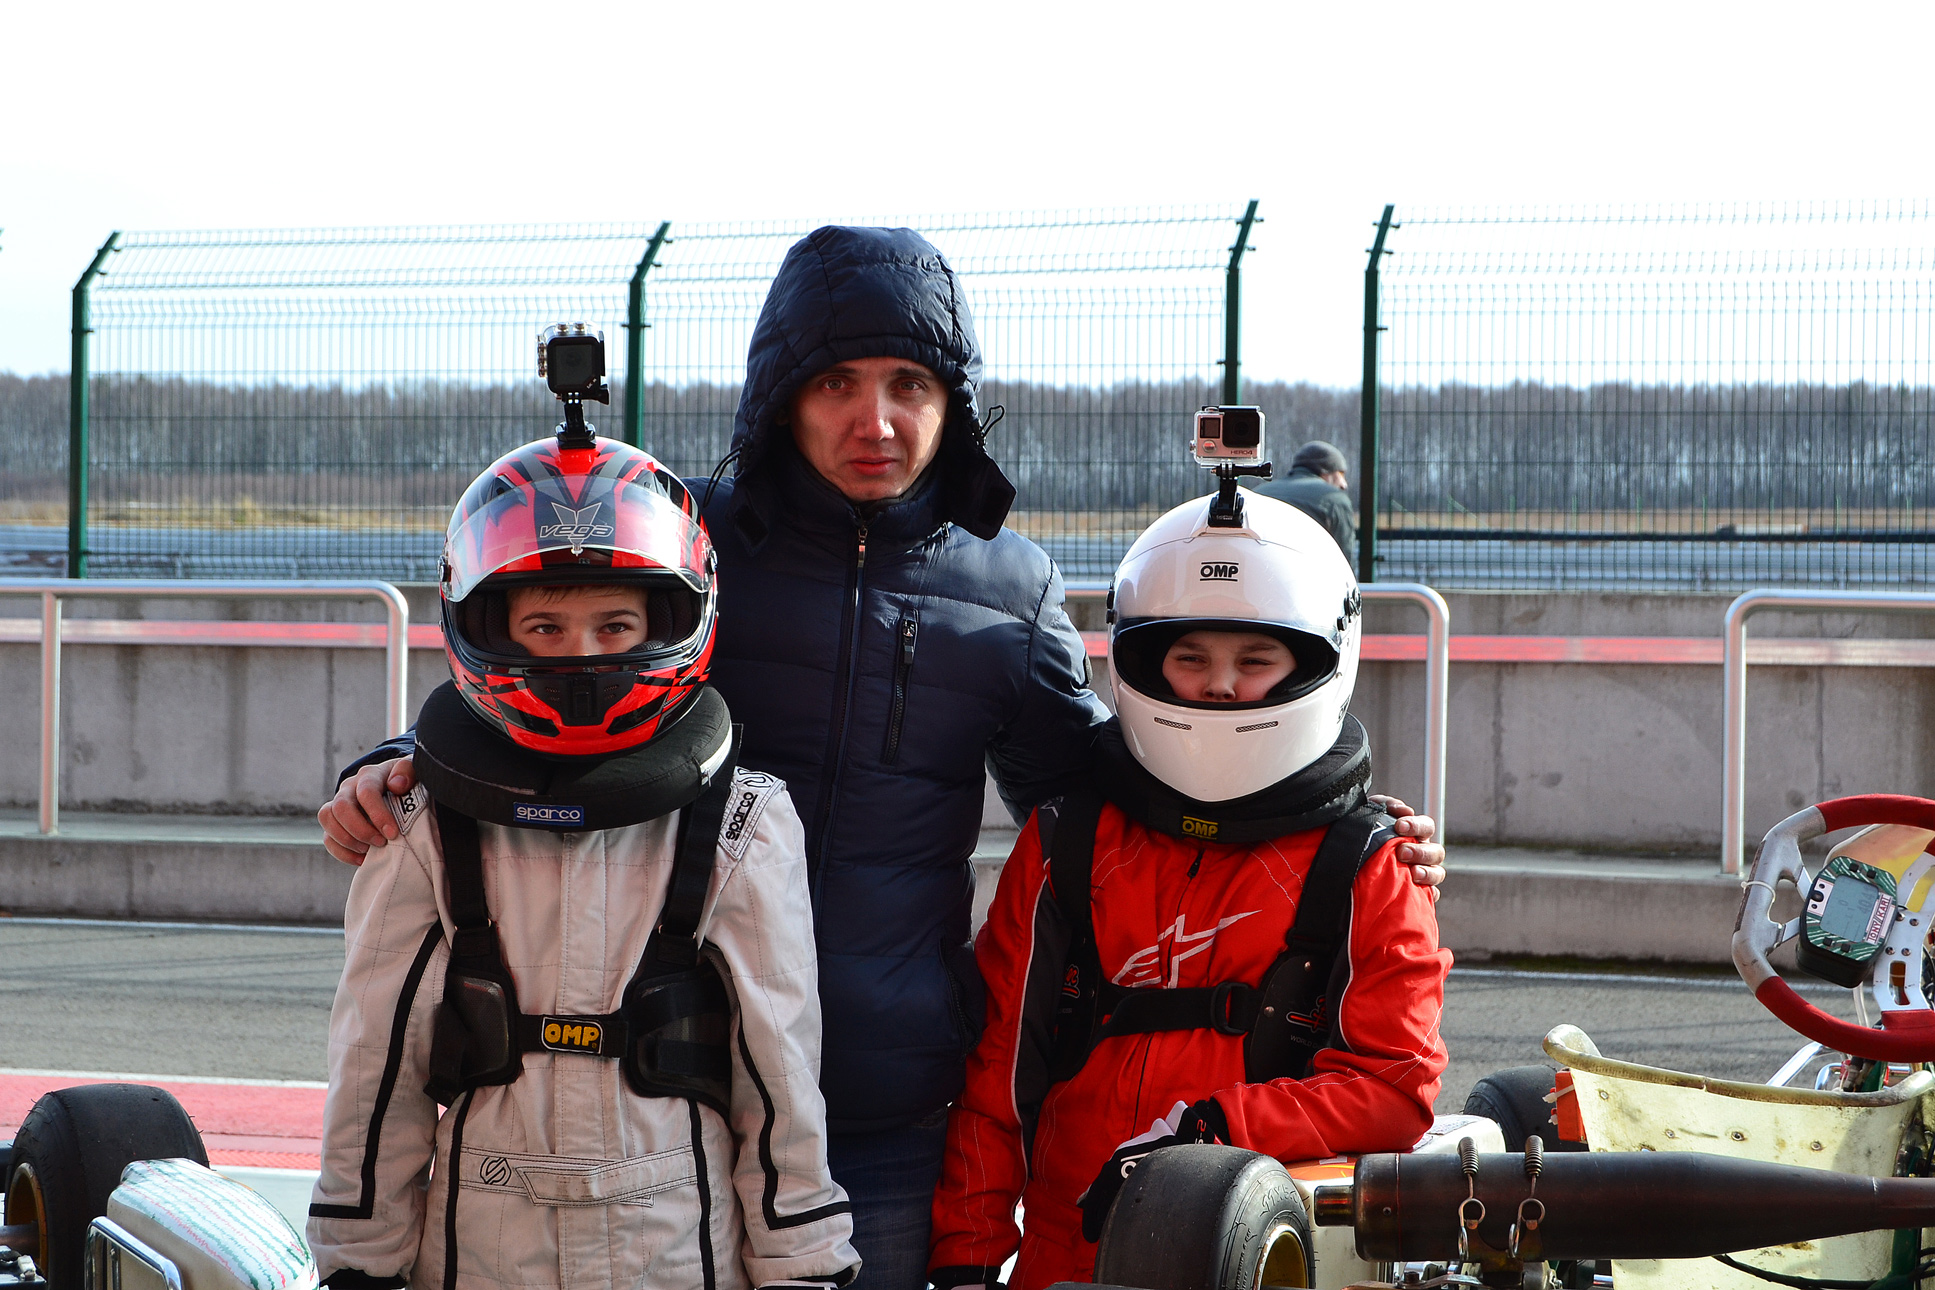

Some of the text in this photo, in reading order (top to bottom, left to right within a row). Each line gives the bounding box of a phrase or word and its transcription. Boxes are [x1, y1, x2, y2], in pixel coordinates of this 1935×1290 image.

[539, 524, 615, 540] vega
[1200, 564, 1239, 578] OMP
[516, 806, 581, 821] sparco
[725, 791, 757, 841] sparco
[1182, 819, 1219, 837] OMP
[544, 1023, 600, 1047] OMP
